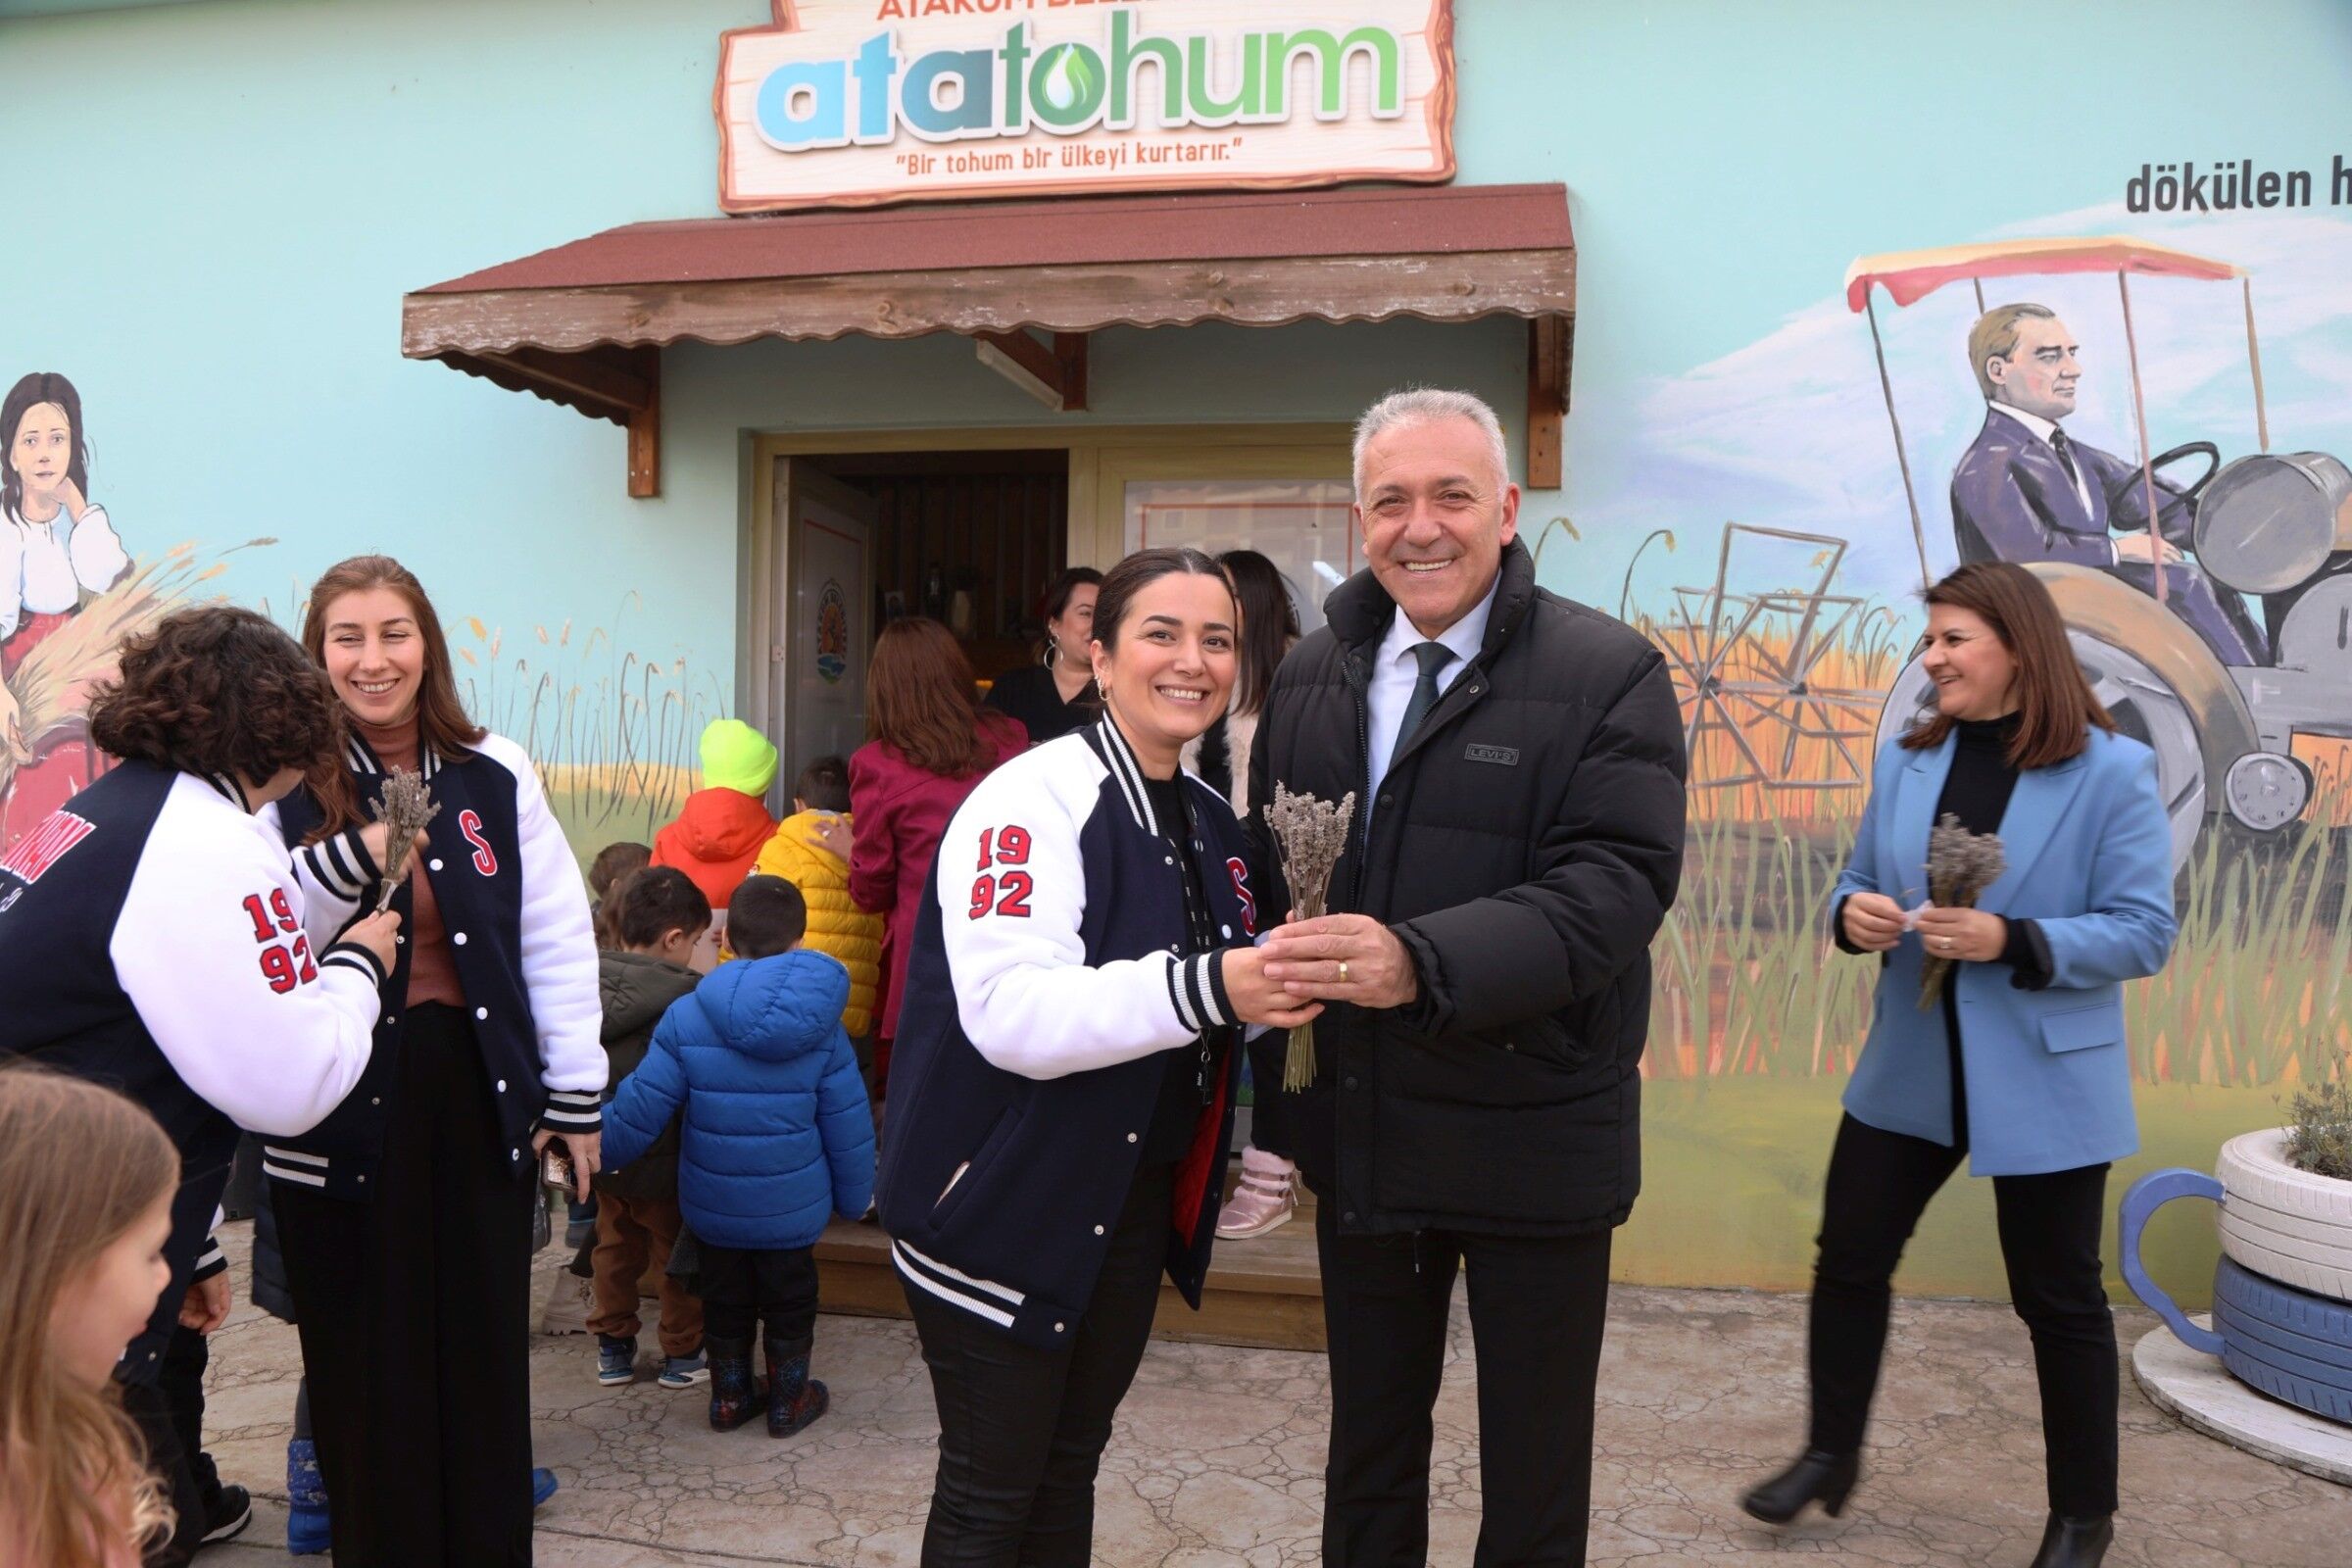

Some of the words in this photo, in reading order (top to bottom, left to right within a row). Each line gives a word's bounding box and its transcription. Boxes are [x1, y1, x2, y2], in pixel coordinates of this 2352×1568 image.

[756, 10, 1399, 141] atatohum
[947, 150, 1014, 173] tohum
[1061, 142, 1127, 172] ülkeyi
[2127, 159, 2312, 213] dökülen
[459, 809, 498, 876] S
[977, 824, 1032, 872] 19
[242, 887, 299, 944] 19
[968, 870, 1033, 921] 92
[1226, 857, 1256, 937] S
[259, 934, 318, 995] 92
